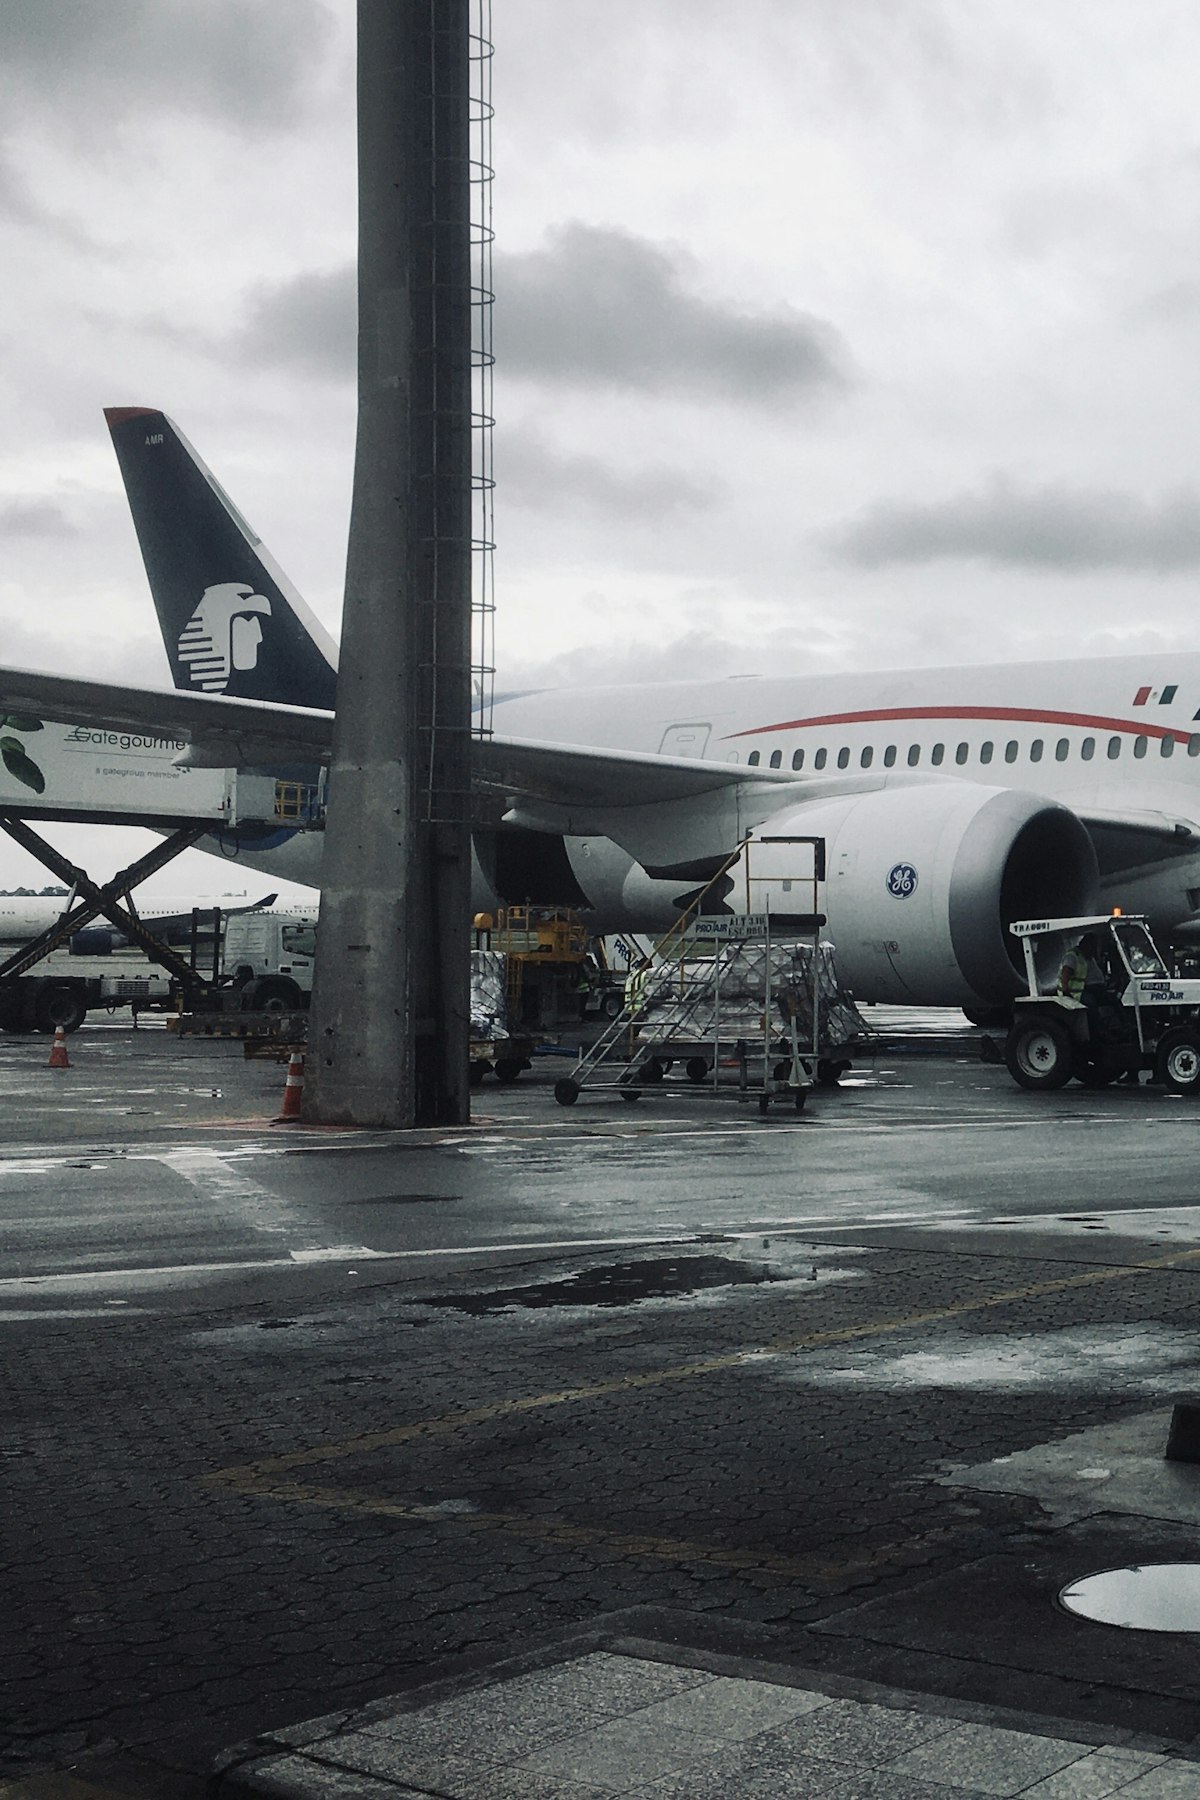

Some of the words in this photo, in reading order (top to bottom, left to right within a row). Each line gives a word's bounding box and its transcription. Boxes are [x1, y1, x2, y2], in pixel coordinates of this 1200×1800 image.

[145, 434, 164, 446] AMR
[696, 924, 712, 933] PRO
[713, 923, 728, 932] AIR
[1151, 992, 1168, 1001] PRO
[1169, 991, 1184, 1000] AIR
